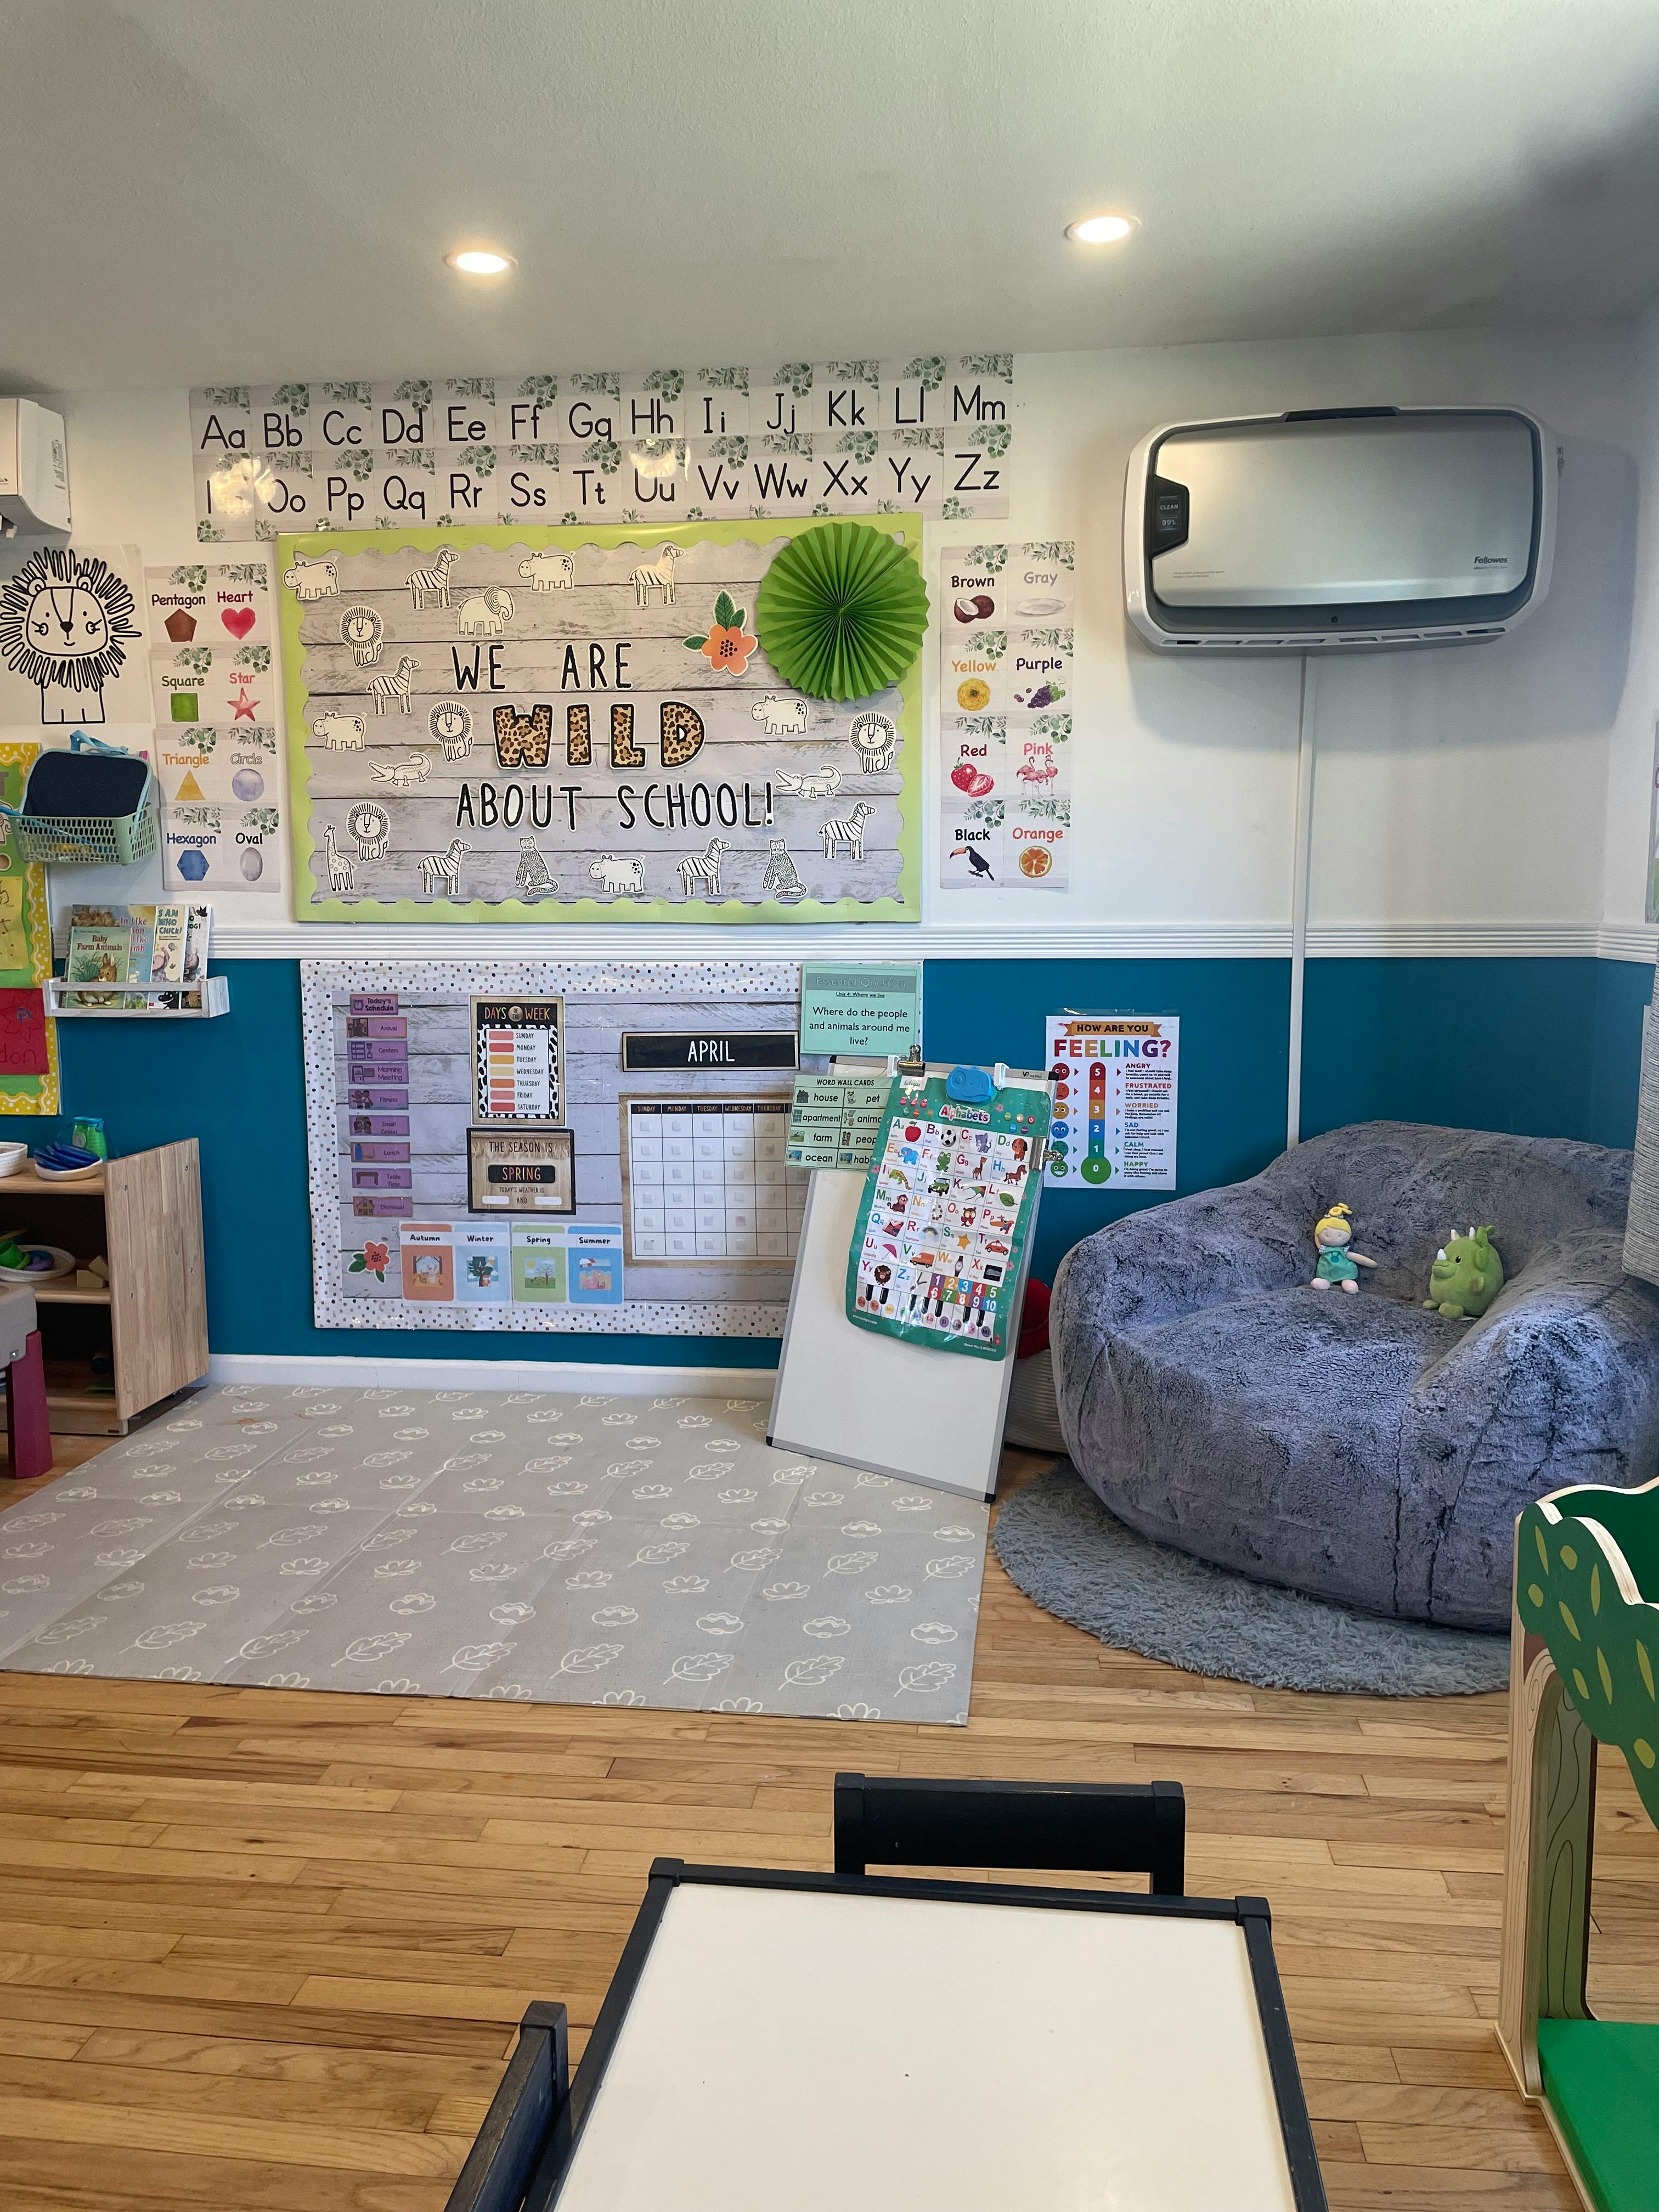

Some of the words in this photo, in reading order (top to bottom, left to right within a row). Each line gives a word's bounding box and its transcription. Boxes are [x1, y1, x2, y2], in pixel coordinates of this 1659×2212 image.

[201, 415, 246, 449] Aa
[264, 413, 303, 449] Bb
[323, 410, 362, 445] Cc
[383, 408, 423, 444] Dd
[448, 406, 486, 441] Ee
[511, 404, 542, 440] Ff
[568, 402, 612, 442] Gg
[631, 398, 673, 435] Hh
[703, 397, 725, 433] Ii
[767, 393, 796, 435] Jj
[828, 390, 865, 427] Kk
[895, 386, 923, 424] Ll
[954, 385, 1005, 422] Mm
[328, 477, 363, 521] Pp
[383, 475, 425, 520] Qq
[450, 473, 483, 509] Rr
[510, 472, 546, 507] Ss
[573, 471, 606, 505] Tt
[634, 467, 675, 503] Uu
[698, 465, 739, 500] Vv
[754, 463, 807, 499] Ww
[822, 460, 868, 496] Xx
[889, 457, 930, 503] Yy
[954, 454, 999, 491] Zz
[951, 575, 995, 588] Brown
[1024, 571, 1058, 586] Gray
[151, 594, 206, 608] Pentagon
[217, 591, 253, 603] Heart
[452, 643, 506, 691] WE
[561, 643, 632, 690] ARE
[952, 659, 996, 672] Yellow
[1016, 658, 1063, 672] Purple
[162, 676, 205, 689] Square
[229, 673, 255, 684] Star
[493, 702, 704, 768] WILD
[961, 744, 987, 757] Red
[1024, 742, 1053, 755] Pink
[162, 754, 210, 768] Triangle
[230, 753, 262, 765] Circle
[456, 783, 582, 831] ABOUT
[618, 782, 773, 829] SCHOOL!
[167, 833, 216, 846] Hexagon
[235, 833, 263, 845] Oval
[955, 828, 990, 842] Black
[1012, 827, 1063, 844] Orange
[158, 918, 177, 926] WHO
[132, 935, 149, 943] Like
[816, 977, 857, 986] Essential
[861, 978, 906, 988] Question
[484, 1007, 506, 1020] DAYS
[524, 1007, 550, 1020] WEEK
[812, 1007, 844, 1015] Where
[878, 1009, 907, 1019] people
[810, 1022, 825, 1030] and
[862, 1024, 893, 1032] around
[1104, 1024, 1124, 1032] ARE
[850, 1037, 868, 1045] live?
[687, 1040, 735, 1062] APRIL
[1054, 1039, 1171, 1058] FEELING?
[814, 1093, 838, 1102] house
[866, 1094, 880, 1104] pet
[803, 1114, 840, 1122] apartment
[941, 1105, 988, 1122] Alphabets
[814, 1133, 832, 1142] farm
[856, 1137, 877, 1145] peop
[489, 1141, 503, 1152] THE
[509, 1142, 540, 1152] SEASON
[545, 1143, 552, 1152] IS
[503, 1167, 541, 1181] SPRING
[526, 1235, 551, 1245] Spring
[579, 1237, 611, 1245] Summer
[936, 1275, 940, 1285] 1
[948, 1278, 955, 1289] 2
[962, 1281, 968, 1291] 3
[975, 1284, 983, 1295] 4
[990, 1287, 997, 1298] 5
[931, 1288, 939, 1298] 6
[946, 1290, 952, 1301] 7
[959, 1294, 966, 1305] 8
[973, 1296, 980, 1307] 9
[986, 1300, 996, 1311] 10
